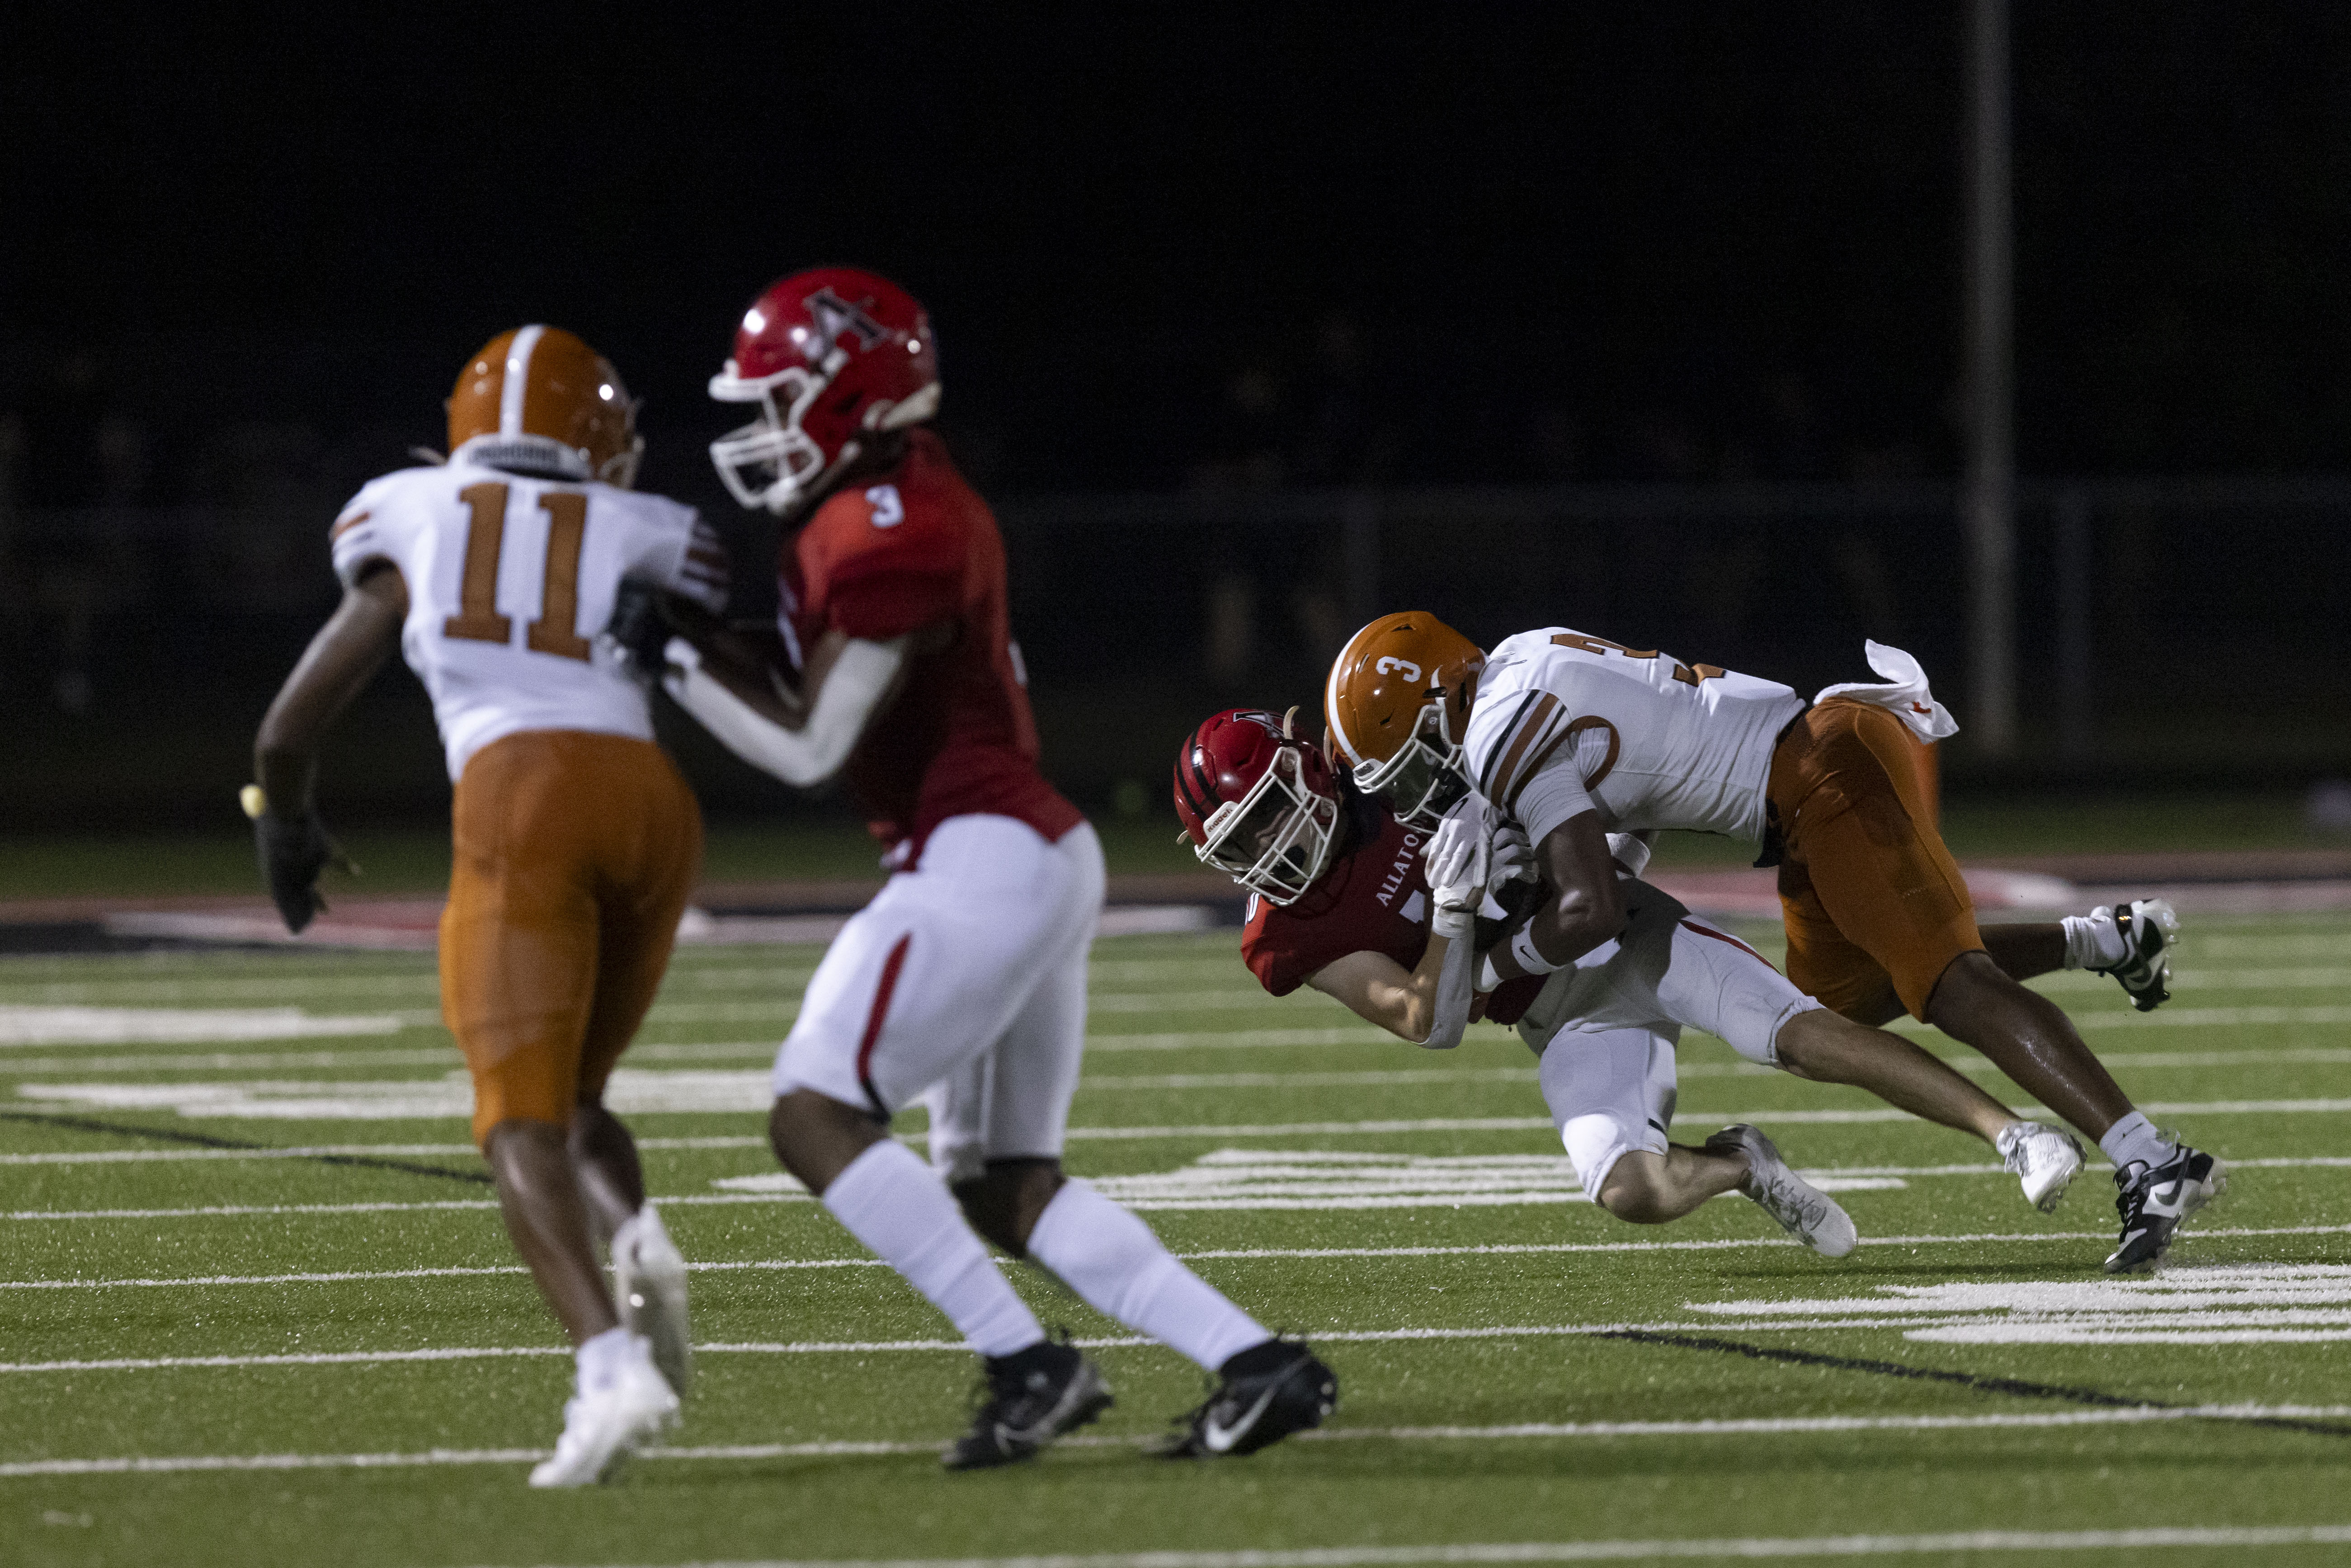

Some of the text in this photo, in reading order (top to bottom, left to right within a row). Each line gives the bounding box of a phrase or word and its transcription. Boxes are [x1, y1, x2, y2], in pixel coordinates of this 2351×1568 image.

[865, 485, 905, 527] 3
[443, 481, 592, 662] 11
[1376, 656, 1421, 683] 3
[1376, 834, 1419, 907] ALLATO
